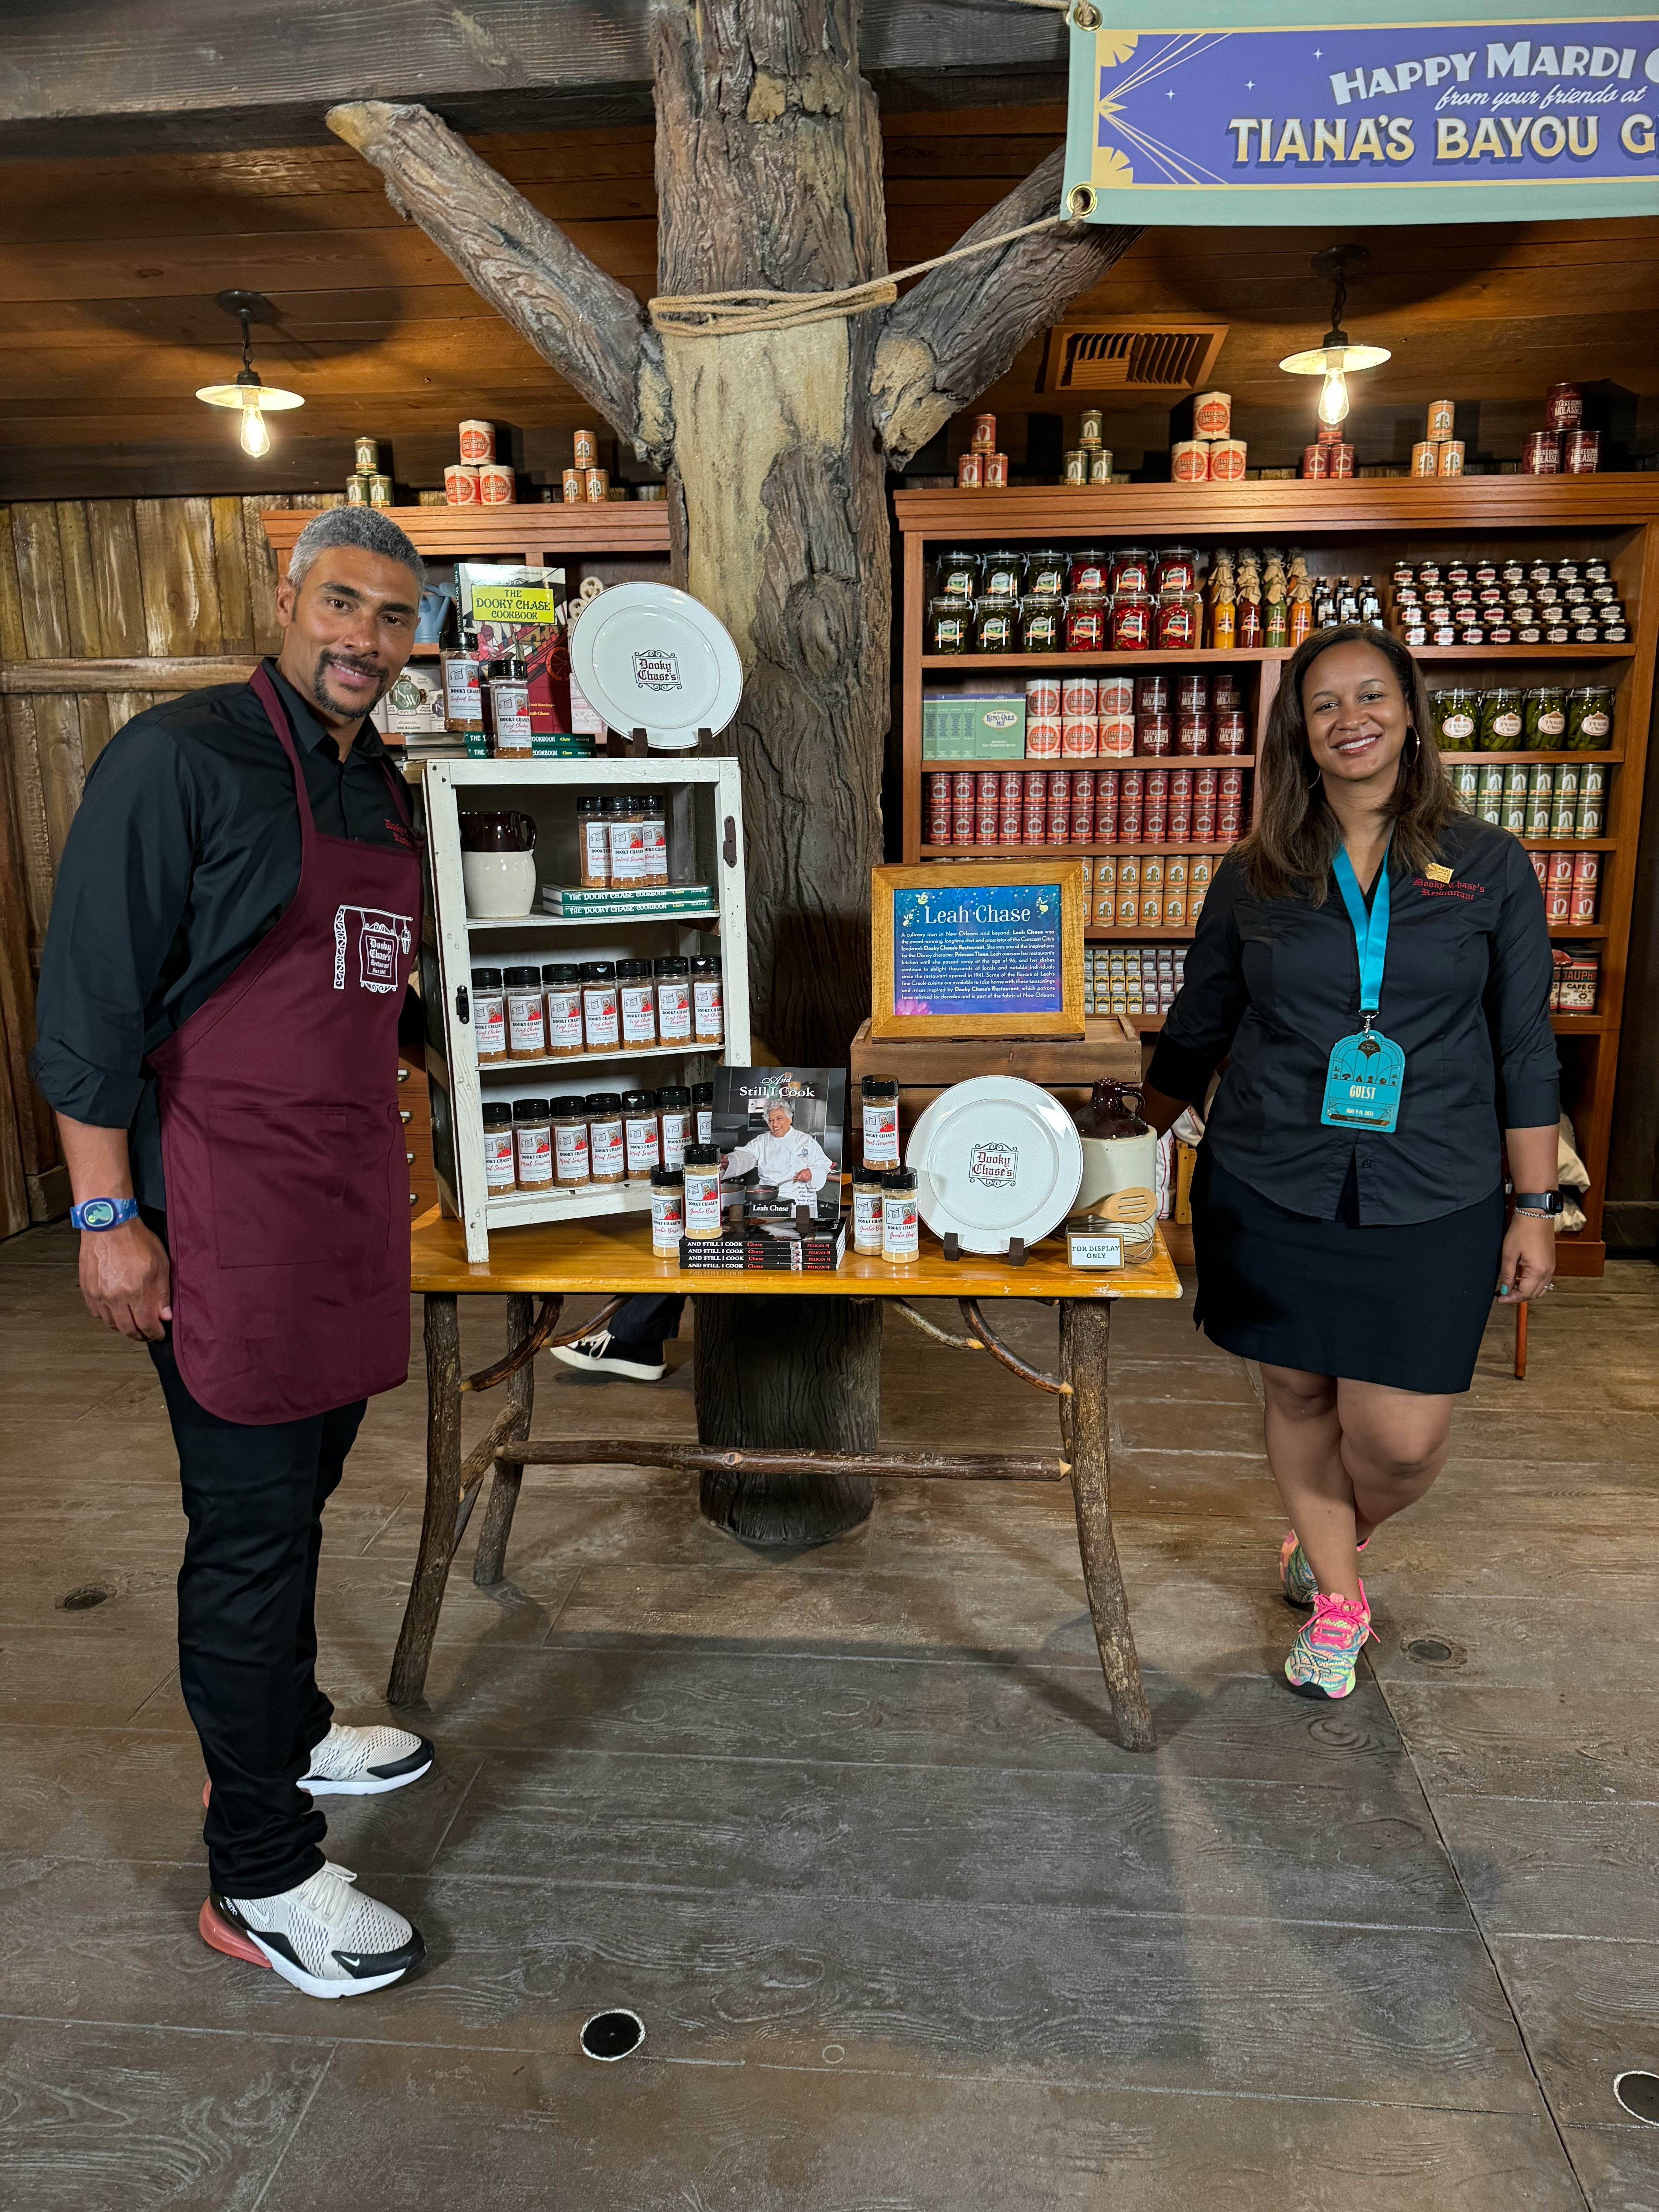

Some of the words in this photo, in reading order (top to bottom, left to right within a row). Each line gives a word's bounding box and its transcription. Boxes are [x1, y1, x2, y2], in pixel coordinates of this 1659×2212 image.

[1329, 51, 1477, 105] HAPPY
[1486, 40, 1637, 79] MARDI
[1435, 85, 1489, 111] from
[1491, 88, 1540, 112] your
[1540, 83, 1618, 110] friends
[1620, 86, 1648, 103] at
[1228, 114, 1416, 163] TIANA'S
[1435, 115, 1599, 160] BAYOU
[505, 589, 522, 598] THE
[476, 598, 513, 609] DOOKY
[515, 600, 551, 611] CHASE
[491, 610, 538, 620] COOKBOOK
[639, 659, 672, 672] Dooky
[637, 670, 677, 681] Chase's
[1413, 878, 1445, 890] Dooky
[1448, 881, 1485, 893] Chase's
[584, 892, 608, 900] DOOKY
[584, 905, 608, 914] DOOKY
[925, 905, 969, 924] Leah
[975, 904, 1030, 923] Chase
[369, 938, 392, 953] Dooky
[369, 948, 391, 962] Chase's
[760, 1073, 792, 1085] And
[739, 1086, 768, 1097] Still
[769, 1087, 778, 1096] I
[779, 1086, 816, 1097] Cook
[1349, 1085, 1377, 1099] GUEST
[977, 1151, 1011, 1167] Dooky
[973, 1163, 1013, 1177] Chase's
[753, 1204, 768, 1212] Leah
